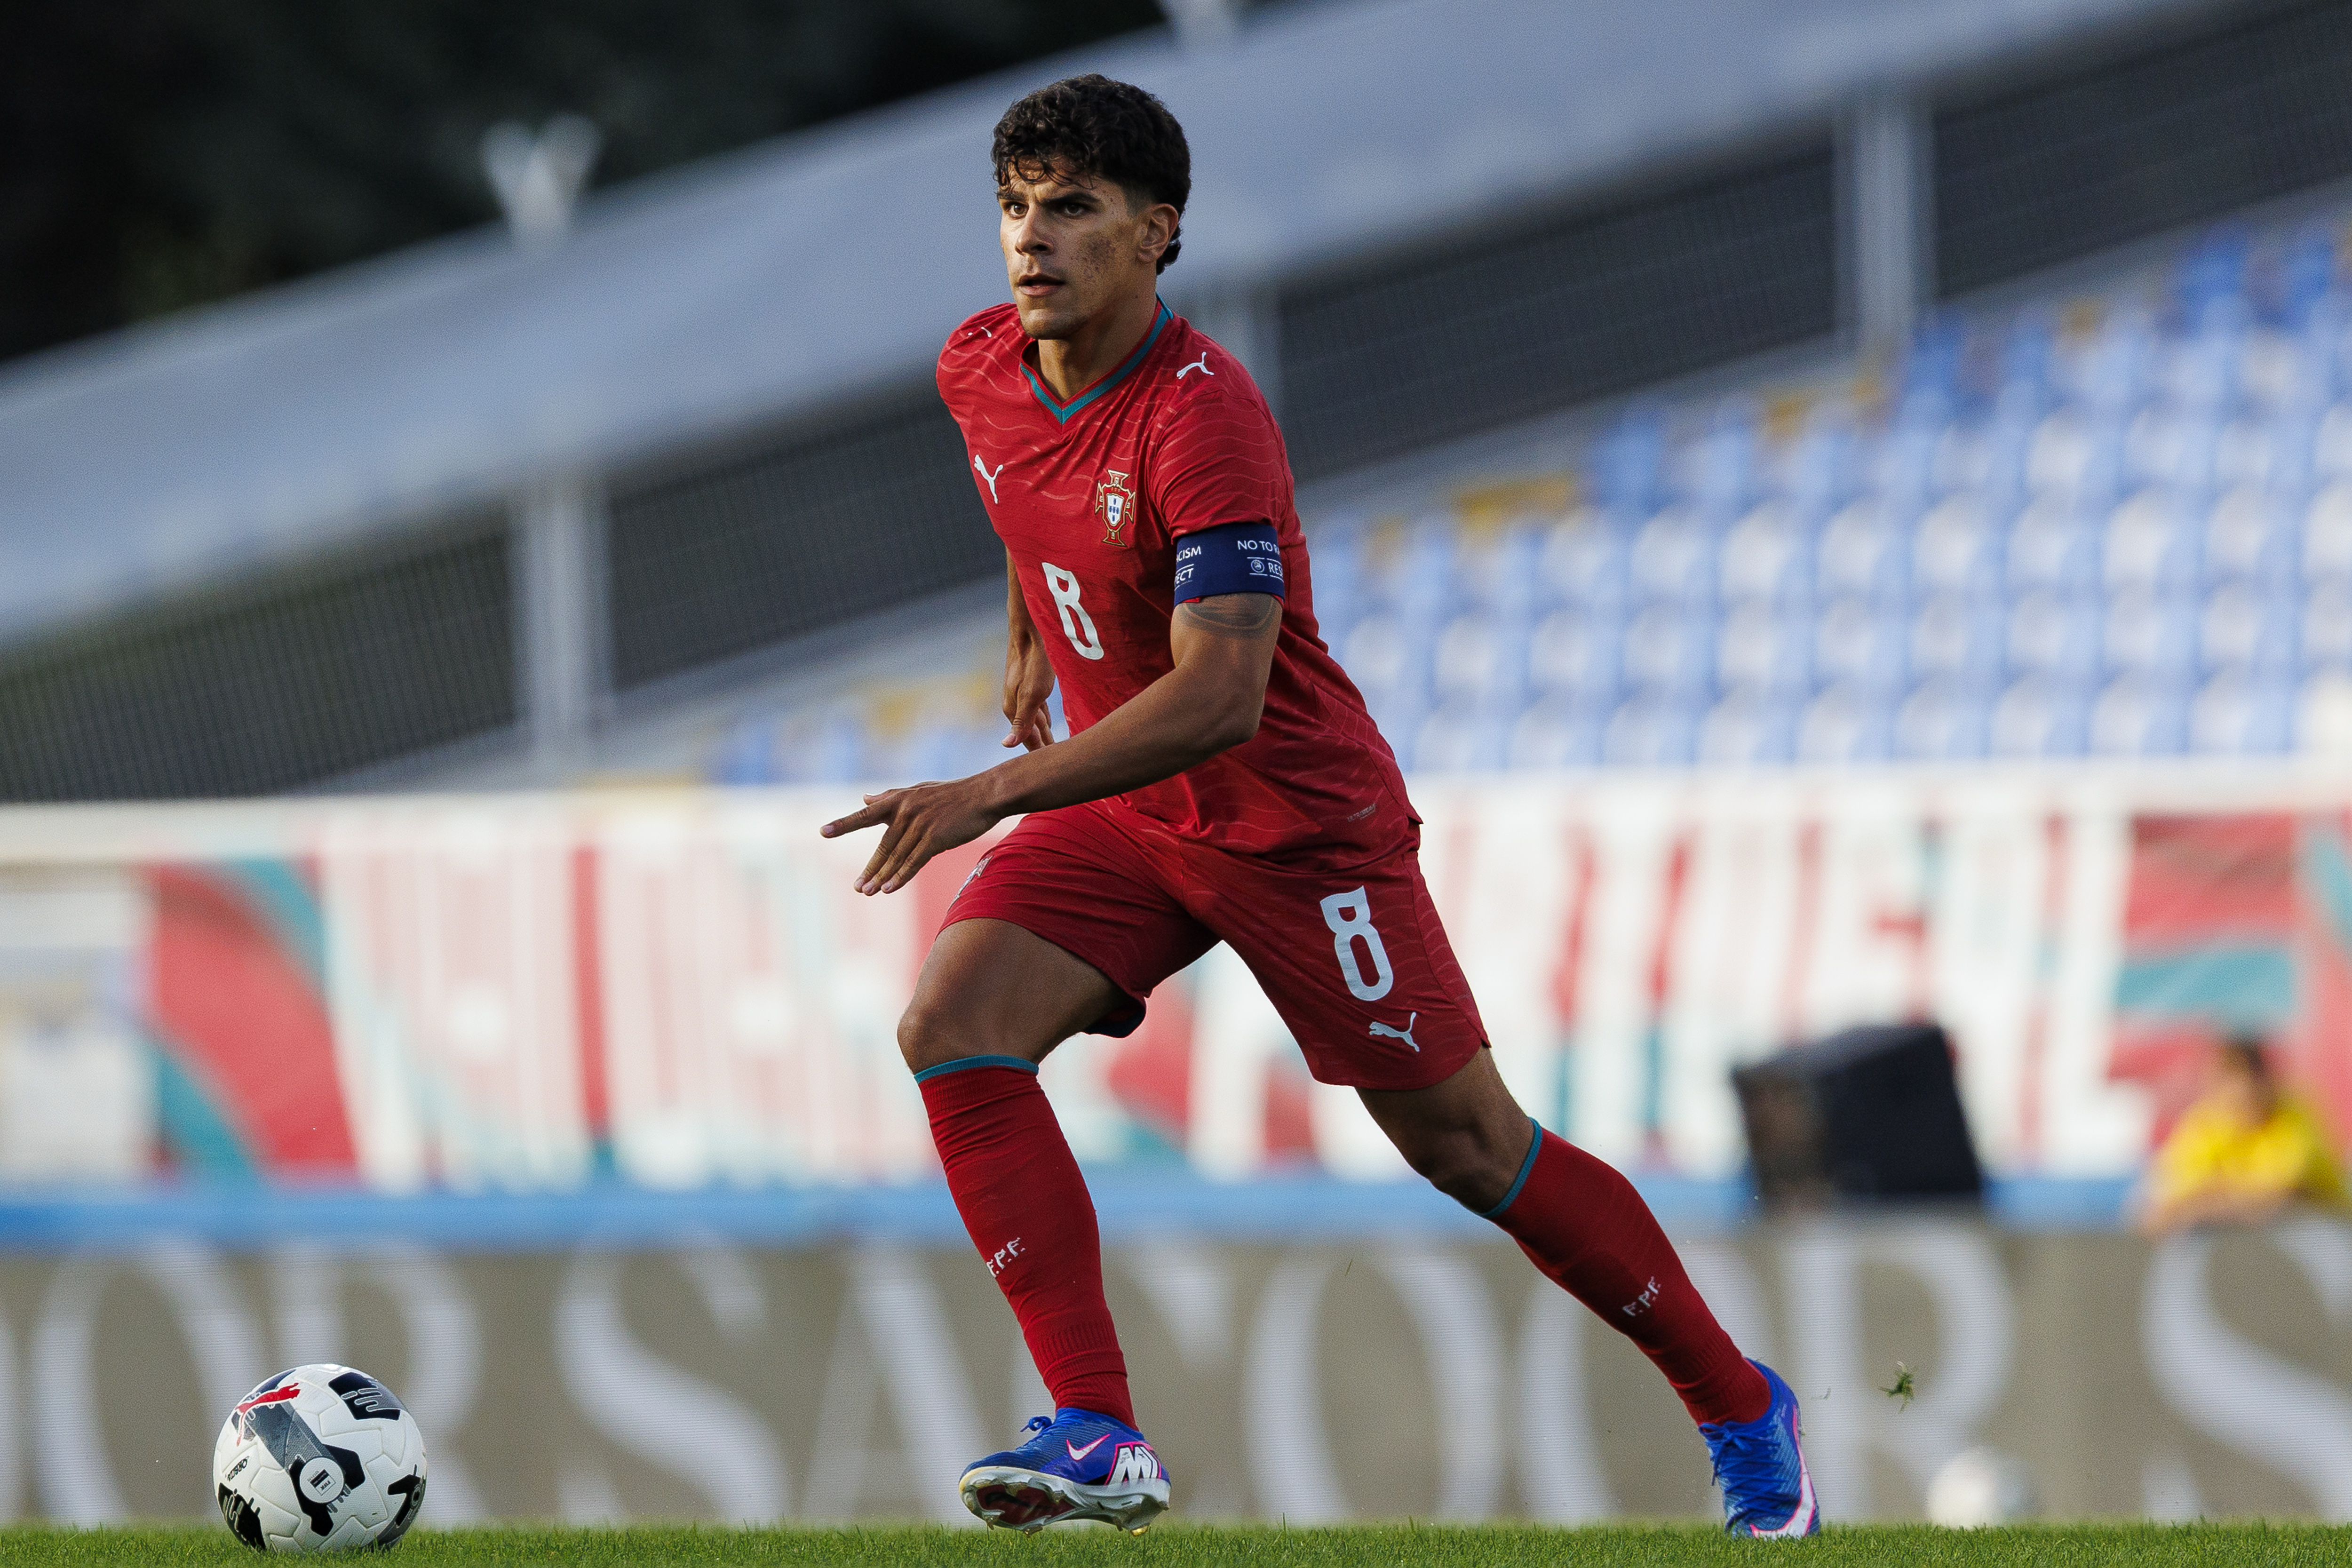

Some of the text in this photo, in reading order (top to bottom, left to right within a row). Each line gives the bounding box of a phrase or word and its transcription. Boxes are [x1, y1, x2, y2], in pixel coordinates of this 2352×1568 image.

[1237, 540, 1257, 550] NO
[1259, 541, 1273, 551] TO
[1041, 562, 1104, 661] 8
[1320, 885, 1394, 1002] 8
[986, 1237, 1026, 1278] F.P.F.
[1623, 1275, 1662, 1317] F.P.F.
